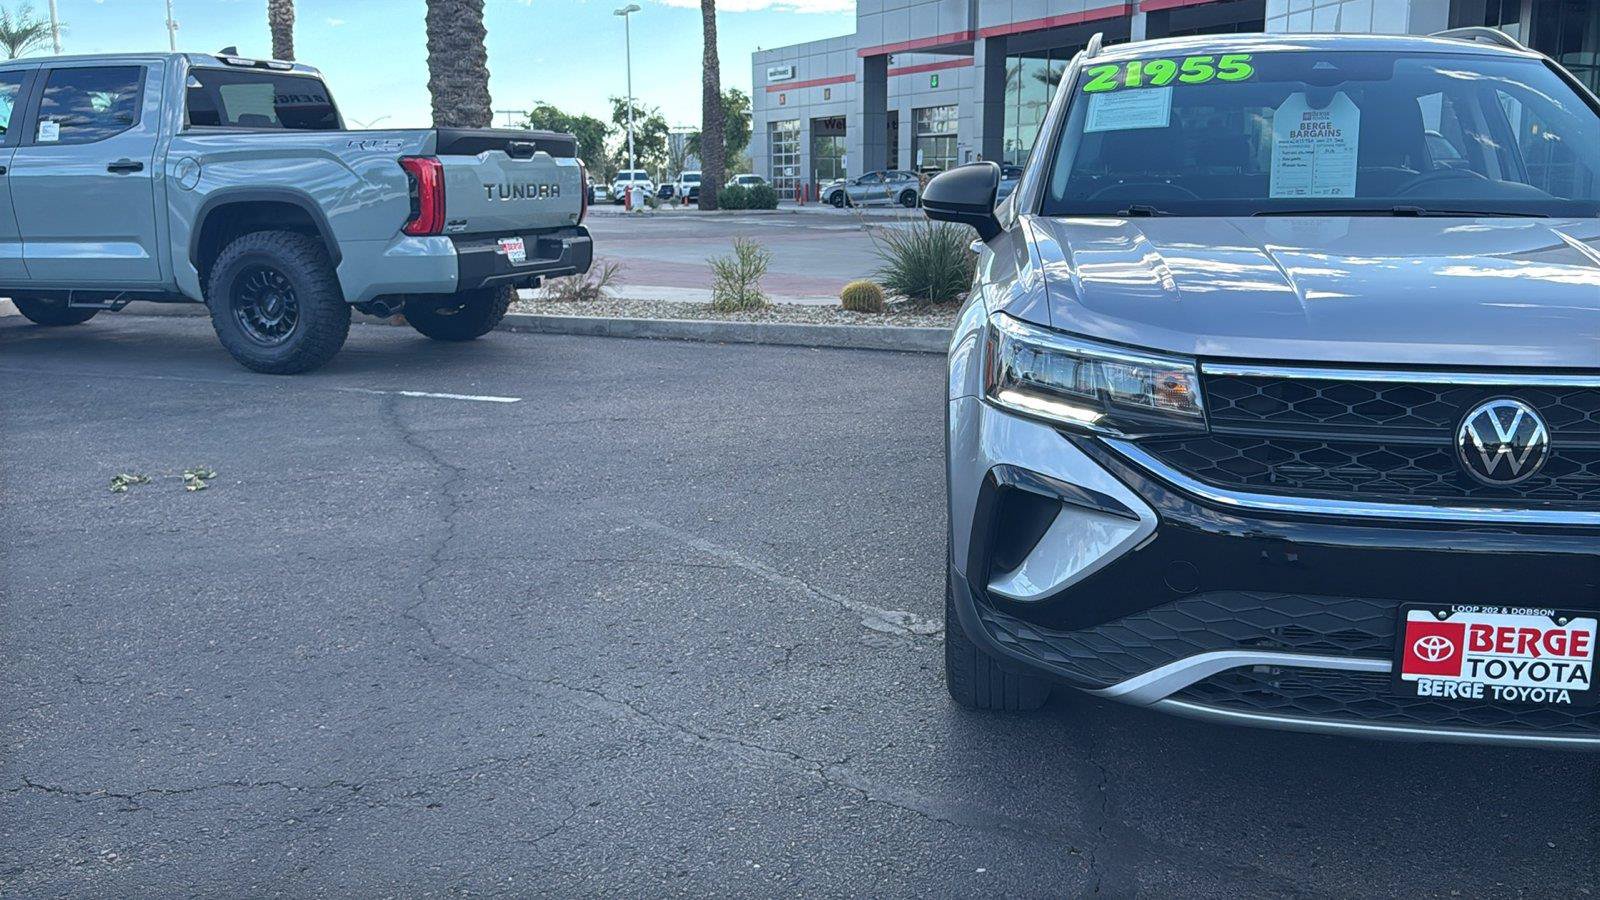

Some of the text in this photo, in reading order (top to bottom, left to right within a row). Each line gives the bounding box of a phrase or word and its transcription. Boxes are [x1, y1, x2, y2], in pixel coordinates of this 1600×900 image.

[1083, 54, 1255, 92] 21955
[1289, 129, 1341, 139] BARGAINS
[1300, 122, 1332, 130] BERGE
[483, 183, 561, 201] TUNDRA
[1451, 605, 1479, 613] LOOP
[1482, 606, 1499, 614] 202
[1511, 608, 1555, 617] DOBSON
[1468, 623, 1590, 659] BERGE
[1466, 658, 1589, 684] TOYOTA
[1417, 678, 1572, 704] BERGE TOYOTA
